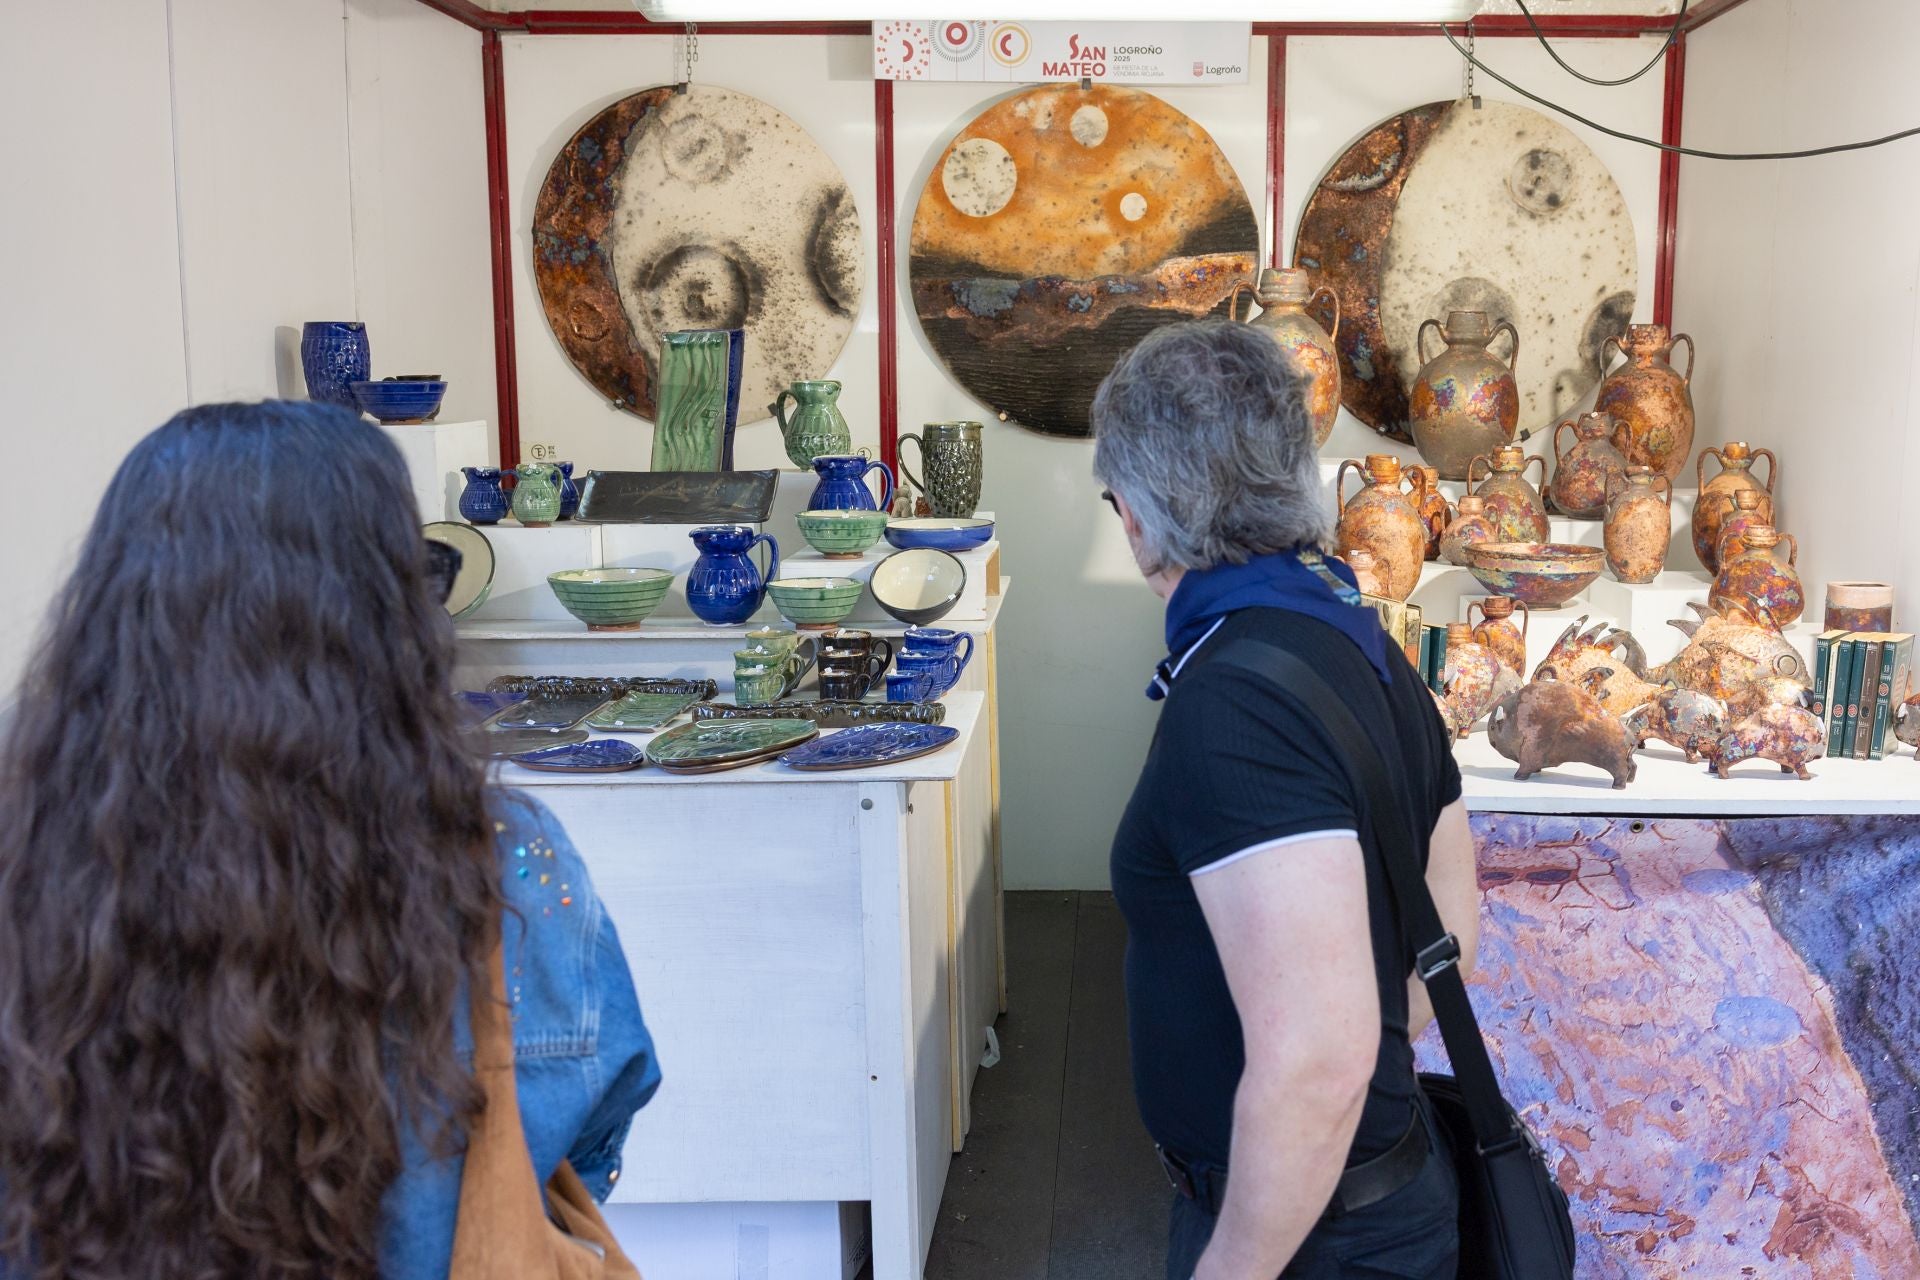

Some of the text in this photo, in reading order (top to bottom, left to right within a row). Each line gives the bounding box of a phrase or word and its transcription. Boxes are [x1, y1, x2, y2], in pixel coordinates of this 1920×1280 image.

[1069, 34, 1106, 61] SAN
[1113, 45, 1163, 55] LOGROÑO
[1043, 62, 1106, 77] MATEO
[1206, 65, 1242, 76] Logroño
